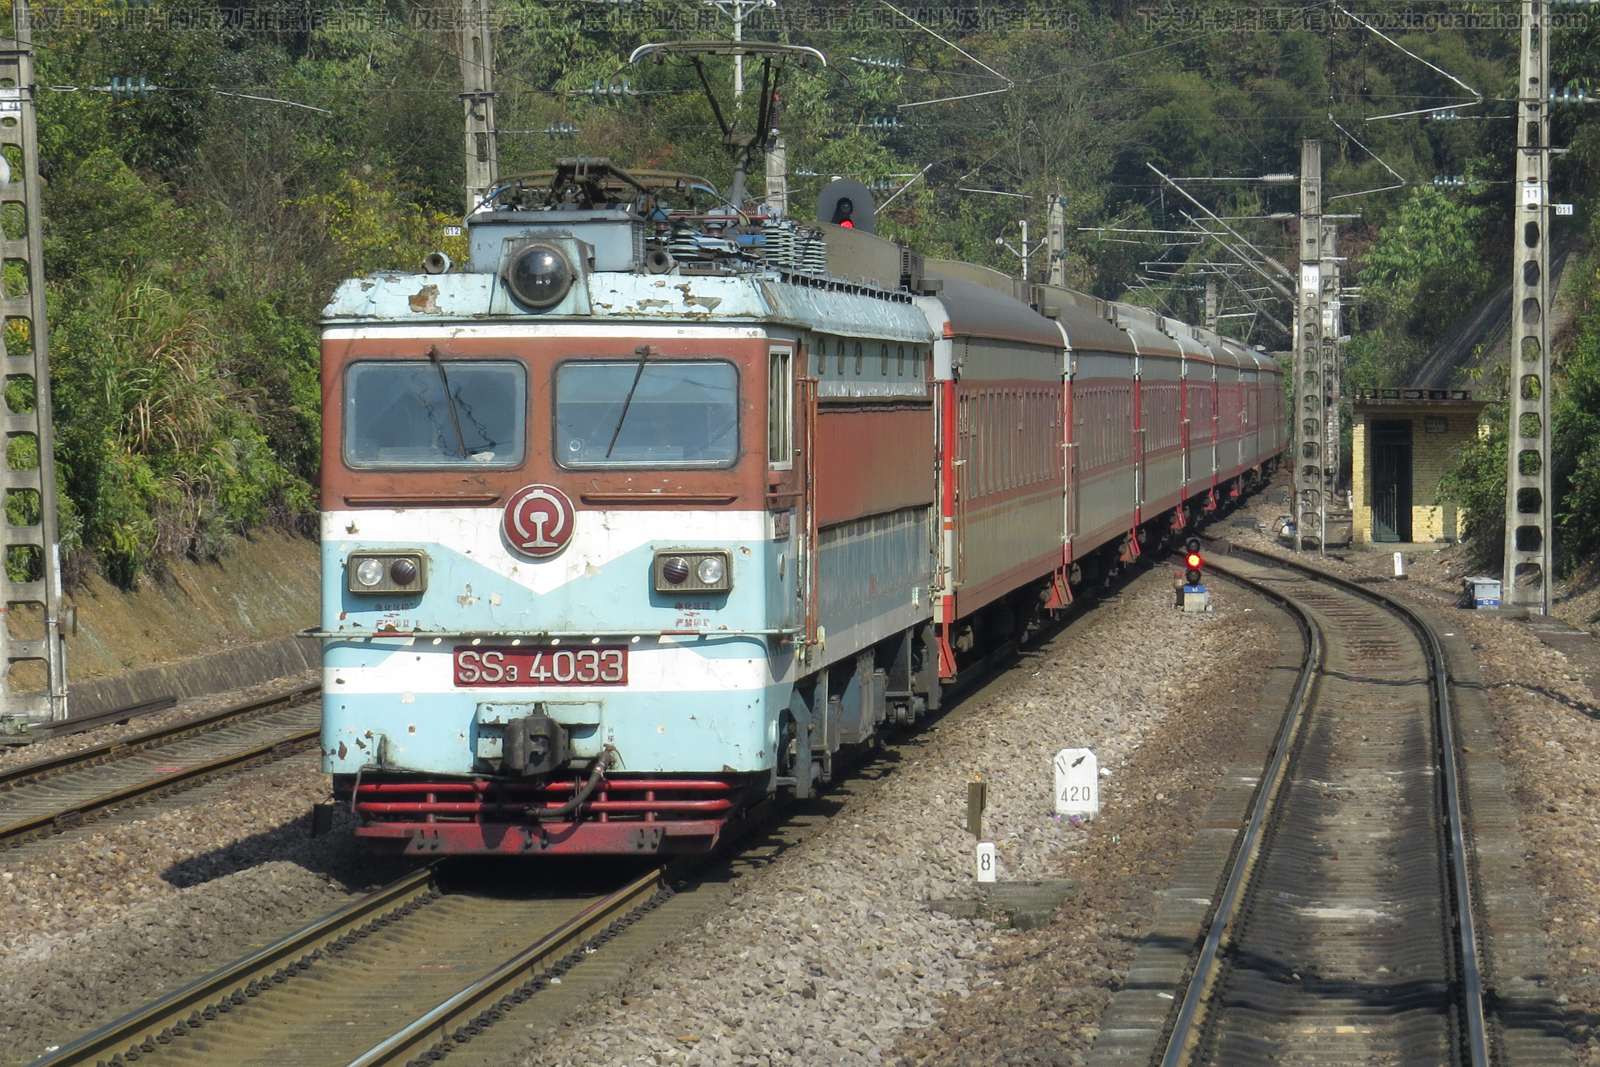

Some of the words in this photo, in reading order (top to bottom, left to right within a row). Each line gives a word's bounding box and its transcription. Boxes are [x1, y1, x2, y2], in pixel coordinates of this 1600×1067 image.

[1526, 189, 1538, 199] 11
[1557, 206, 1571, 214] 011
[445, 227, 460, 235] 012
[457, 650, 518, 683] SS3
[529, 650, 624, 683] 4033
[1060, 786, 1090, 802] 420
[981, 853, 990, 870] 8
